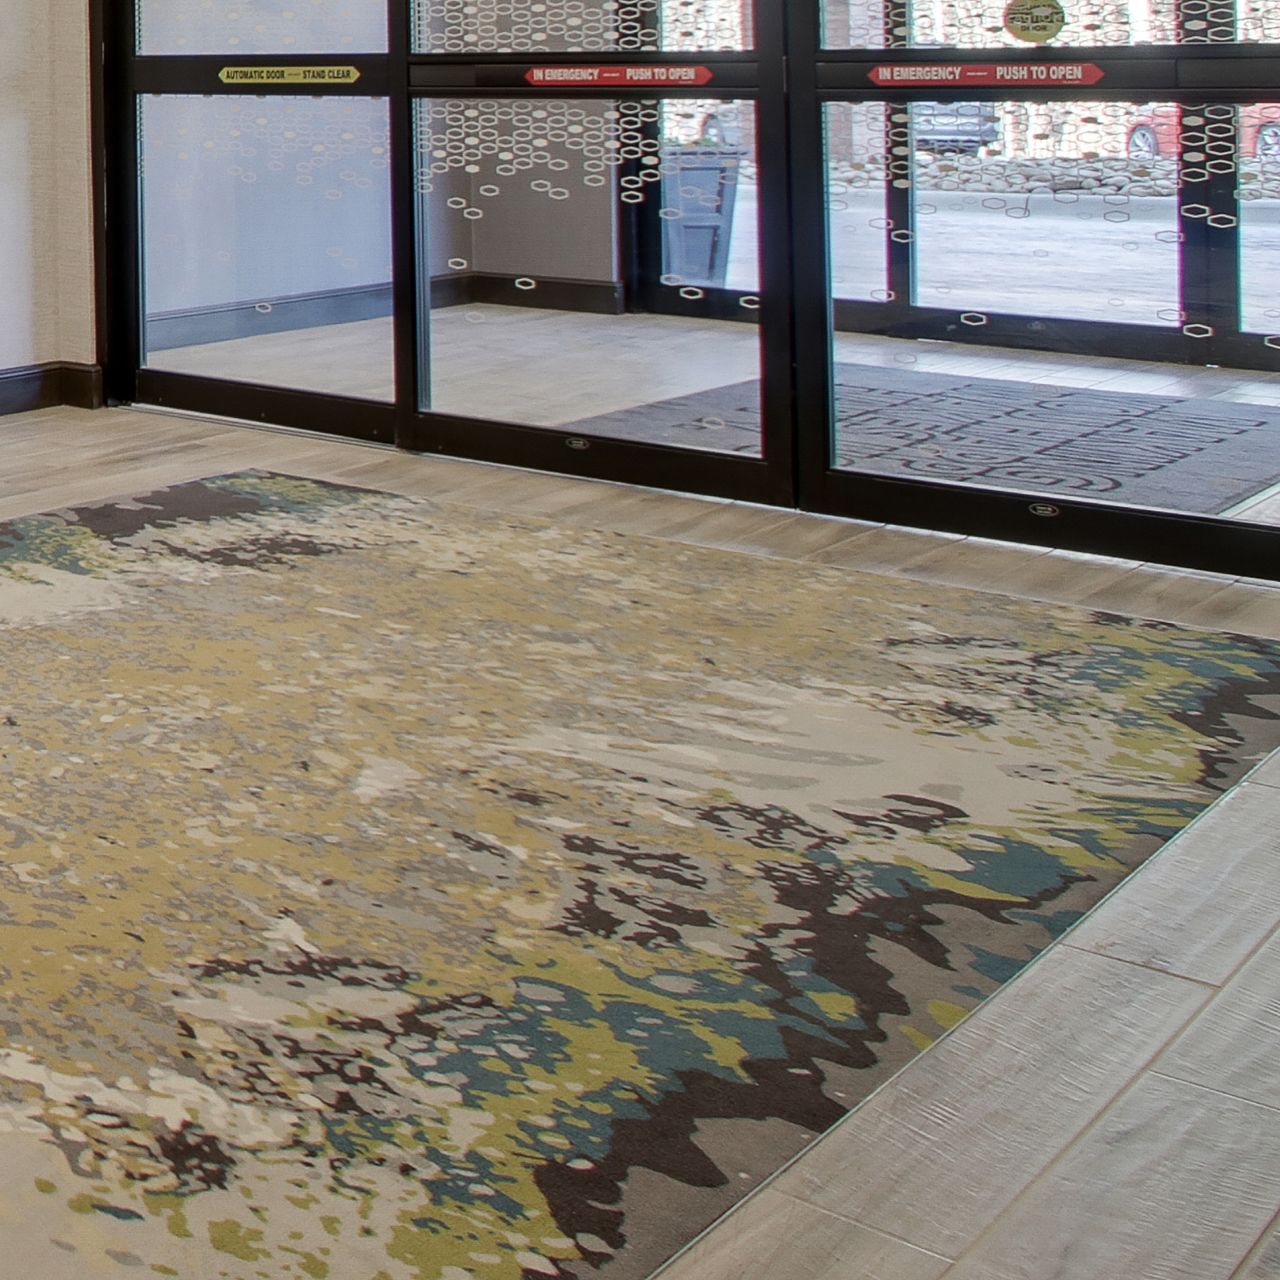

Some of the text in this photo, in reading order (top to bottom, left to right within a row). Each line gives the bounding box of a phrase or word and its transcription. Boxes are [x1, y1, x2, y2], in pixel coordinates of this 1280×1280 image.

[226, 70, 264, 80] AUTOMATIC
[266, 70, 285, 80] DOOR
[302, 69, 325, 80] STAND
[327, 69, 352, 79] CLEAR
[533, 69, 543, 81] IN
[544, 68, 600, 81] EMERGENCY
[626, 68, 652, 80] PUSH
[654, 68, 666, 80] TO
[668, 68, 696, 80] OPEN
[878, 66, 1082, 80] IN EMERGENCY PUSH TO OPEN
